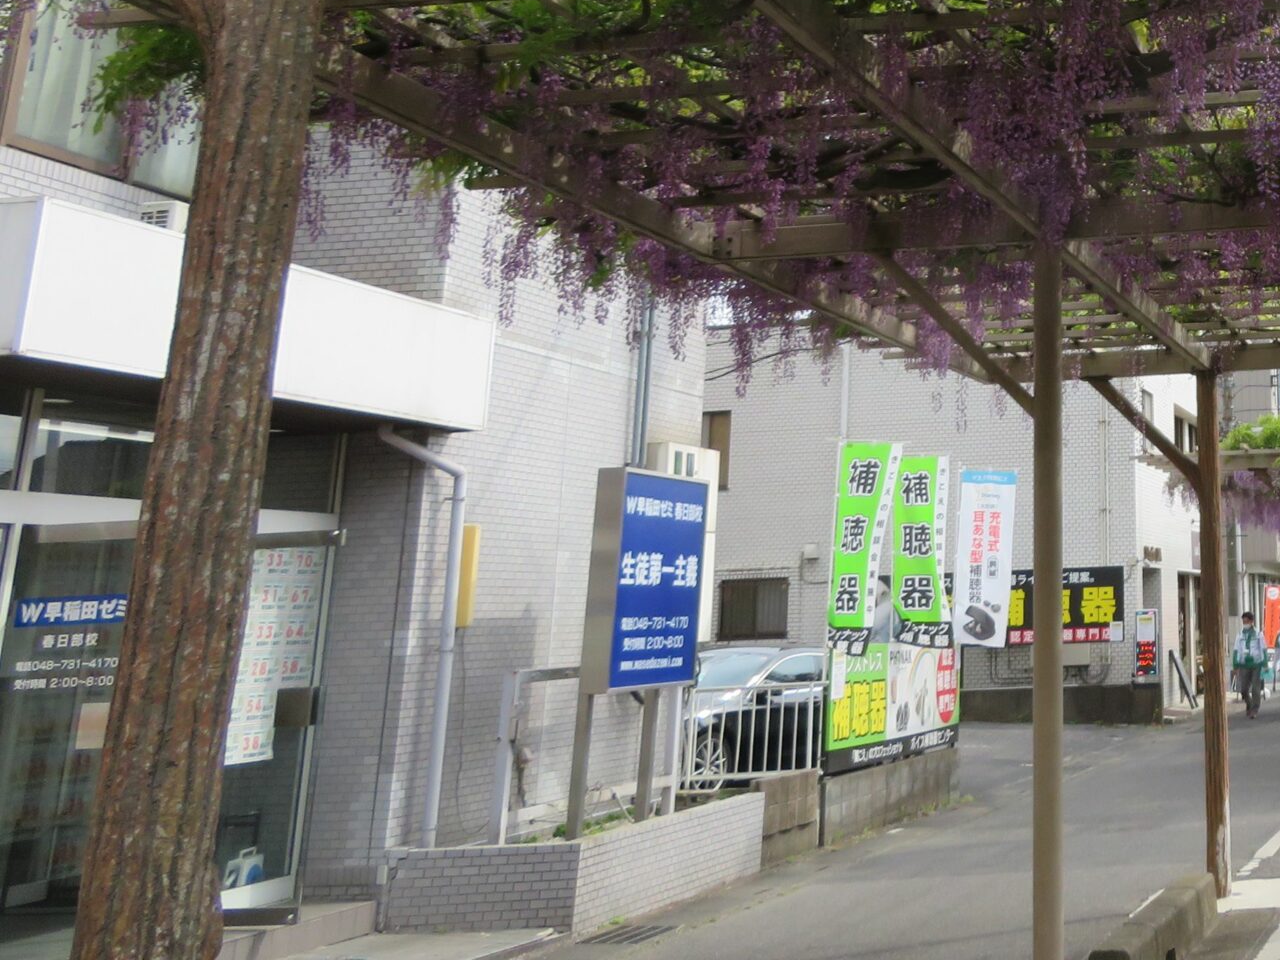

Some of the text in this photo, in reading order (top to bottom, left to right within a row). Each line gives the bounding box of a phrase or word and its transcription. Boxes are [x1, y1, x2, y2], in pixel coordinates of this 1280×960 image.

[835, 459, 881, 614] 補聴器
[900, 472, 935, 610] 補聴器
[988, 511, 1002, 553] 充電式
[620, 551, 699, 588] 生徒第一主義
[21, 599, 128, 623] W早稲田ゼミ
[42, 633, 99, 648] 春日部校
